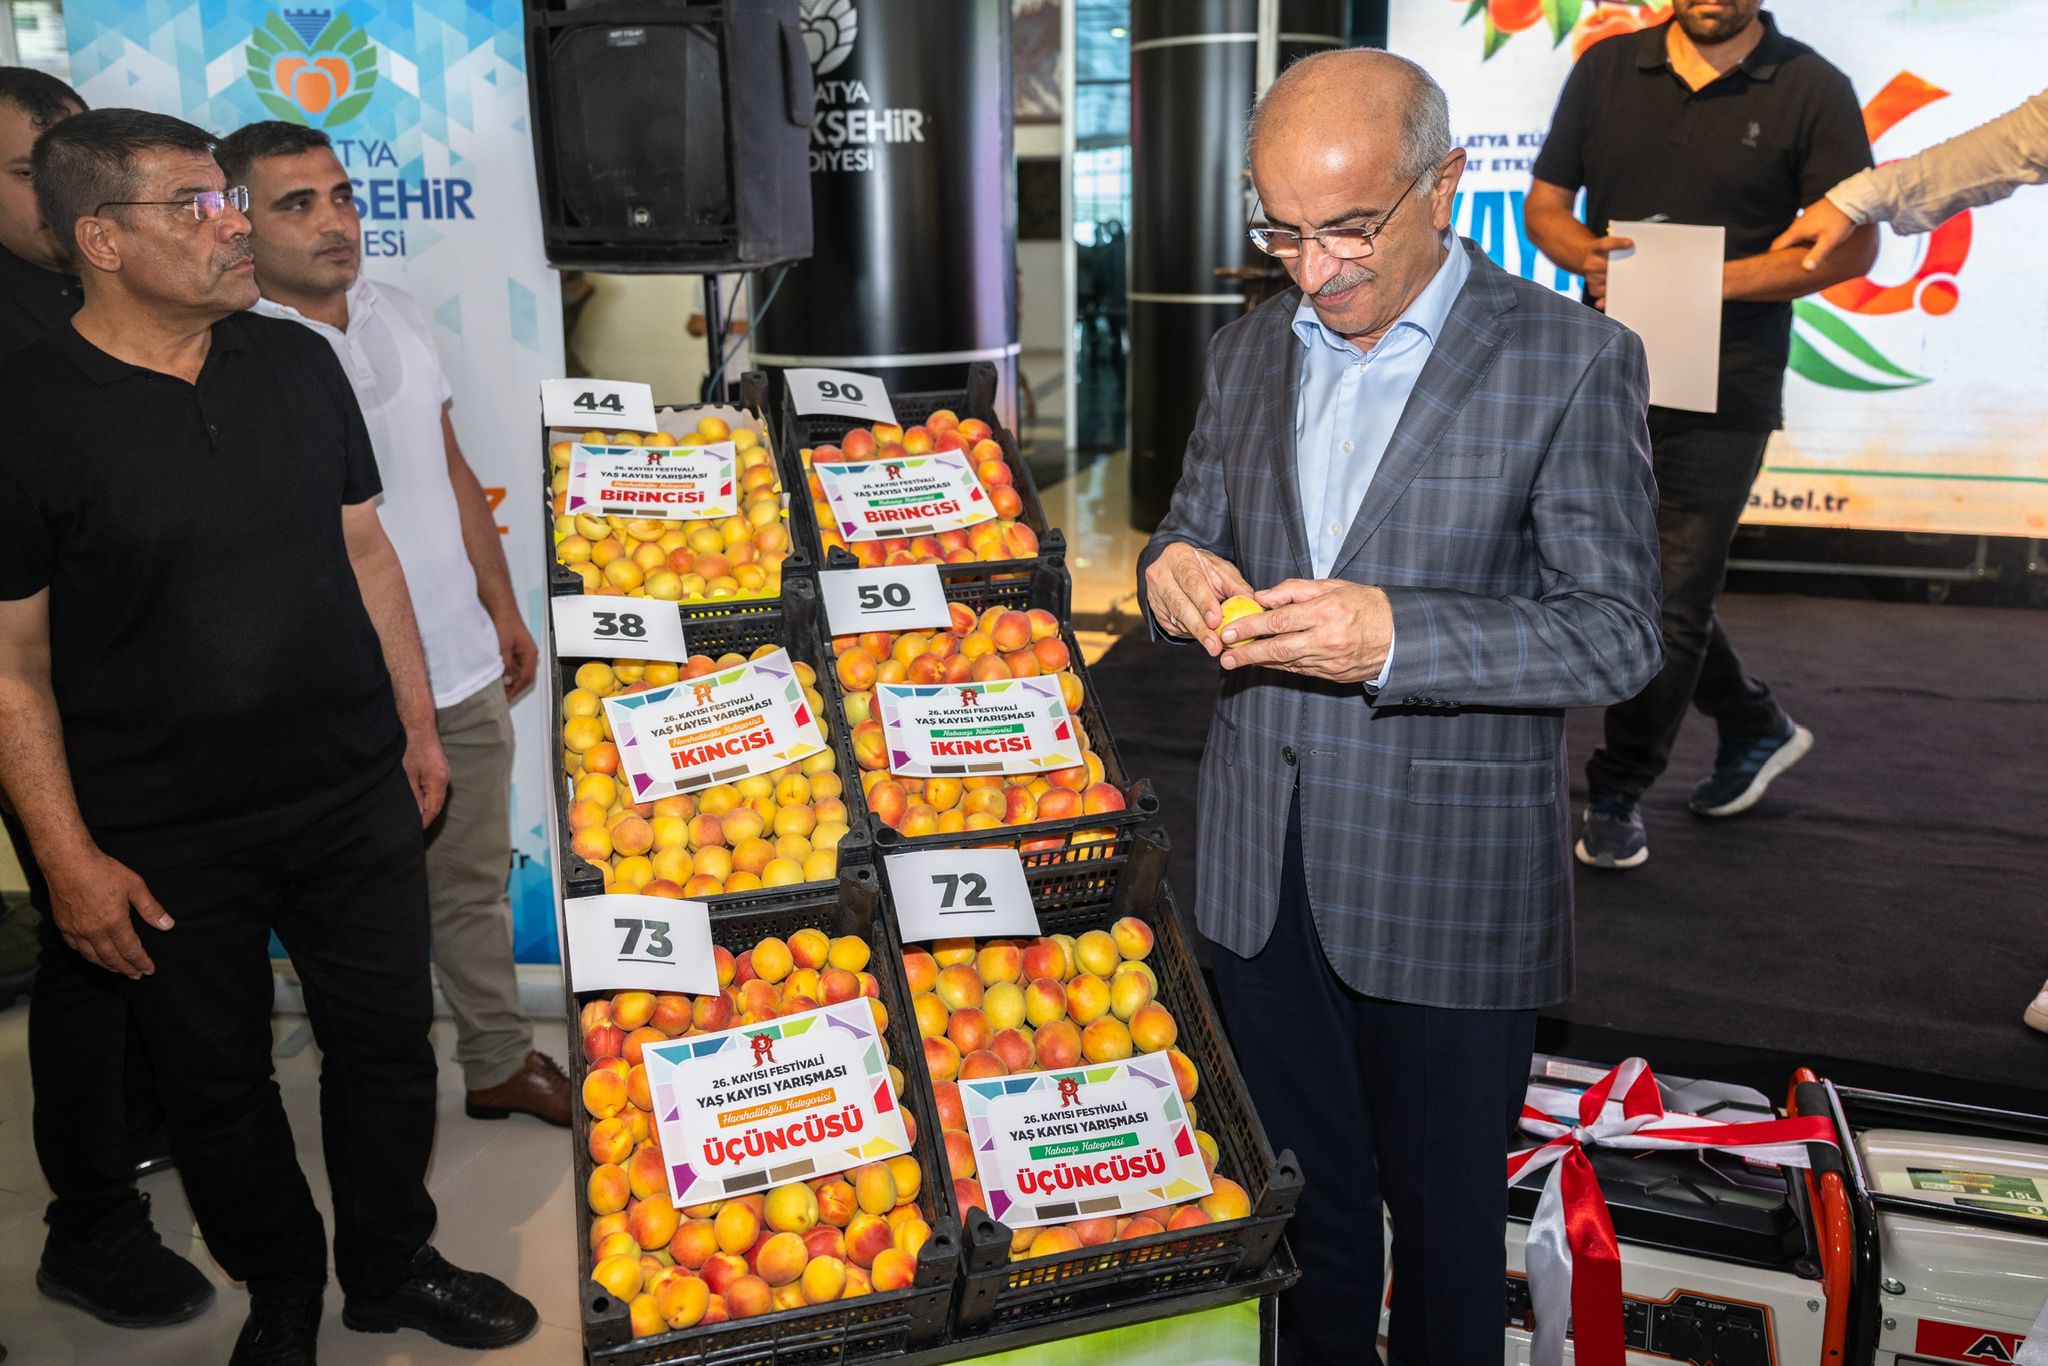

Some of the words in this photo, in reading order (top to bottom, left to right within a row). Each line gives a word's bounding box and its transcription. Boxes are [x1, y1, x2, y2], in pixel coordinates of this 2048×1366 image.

[1451, 134, 1509, 148] LATYA
[573, 391, 625, 412] 44
[817, 380, 864, 402] 90
[655, 472, 708, 480] YARIŞMASI
[875, 481, 899, 489] KAYISI
[600, 489, 705, 504] BİRİNCİSİ
[854, 490, 872, 498] YAŞ
[872, 487, 902, 496] KAYISI
[903, 481, 951, 493] YARIŞMASI
[863, 499, 961, 523] BİRİNCİSİ
[857, 583, 911, 609] 50
[592, 611, 647, 638] 38
[651, 726, 674, 738] YAŞ
[675, 716, 712, 732] KAYISI
[712, 698, 773, 723] YARIŞMASI
[663, 715, 678, 724] 26.
[679, 706, 708, 720] KAYISI
[710, 693, 755, 714] FESTİVALİ
[915, 718, 937, 726] YAŞ
[938, 716, 974, 725] KAYISI
[976, 711, 1035, 723] YARIŞMASI
[943, 708, 972, 716] KAYISI
[974, 704, 1018, 714] FESTİVALİ
[671, 728, 775, 770] İKİNCİSİ
[930, 736, 1032, 756] İKİNCİSİ
[932, 872, 993, 908] 72
[614, 918, 674, 958] 73
[712, 1078, 730, 1089] 26.
[731, 1069, 768, 1085] KAYISI
[770, 1053, 825, 1077] FESTİVALİ
[696, 1094, 725, 1109] YAŞ
[727, 1083, 772, 1103] KAYISI
[773, 1064, 847, 1092] YARIŞMASI
[786, 1091, 833, 1110] Kategorisi
[1023, 1114, 1041, 1124] 26.
[1041, 1110, 1075, 1122] KAYISI
[1076, 1100, 1128, 1117] FESTİVALİ
[703, 1103, 864, 1167] ÜÇÜNCÜSÜ
[1009, 1129, 1035, 1142] YAŞ
[1037, 1121, 1078, 1139] KAYISI
[1079, 1111, 1149, 1132] YARIŞMASI
[1082, 1137, 1125, 1151] Kategorisi
[1016, 1147, 1166, 1196] ÜÇÜNCÜSÜ
